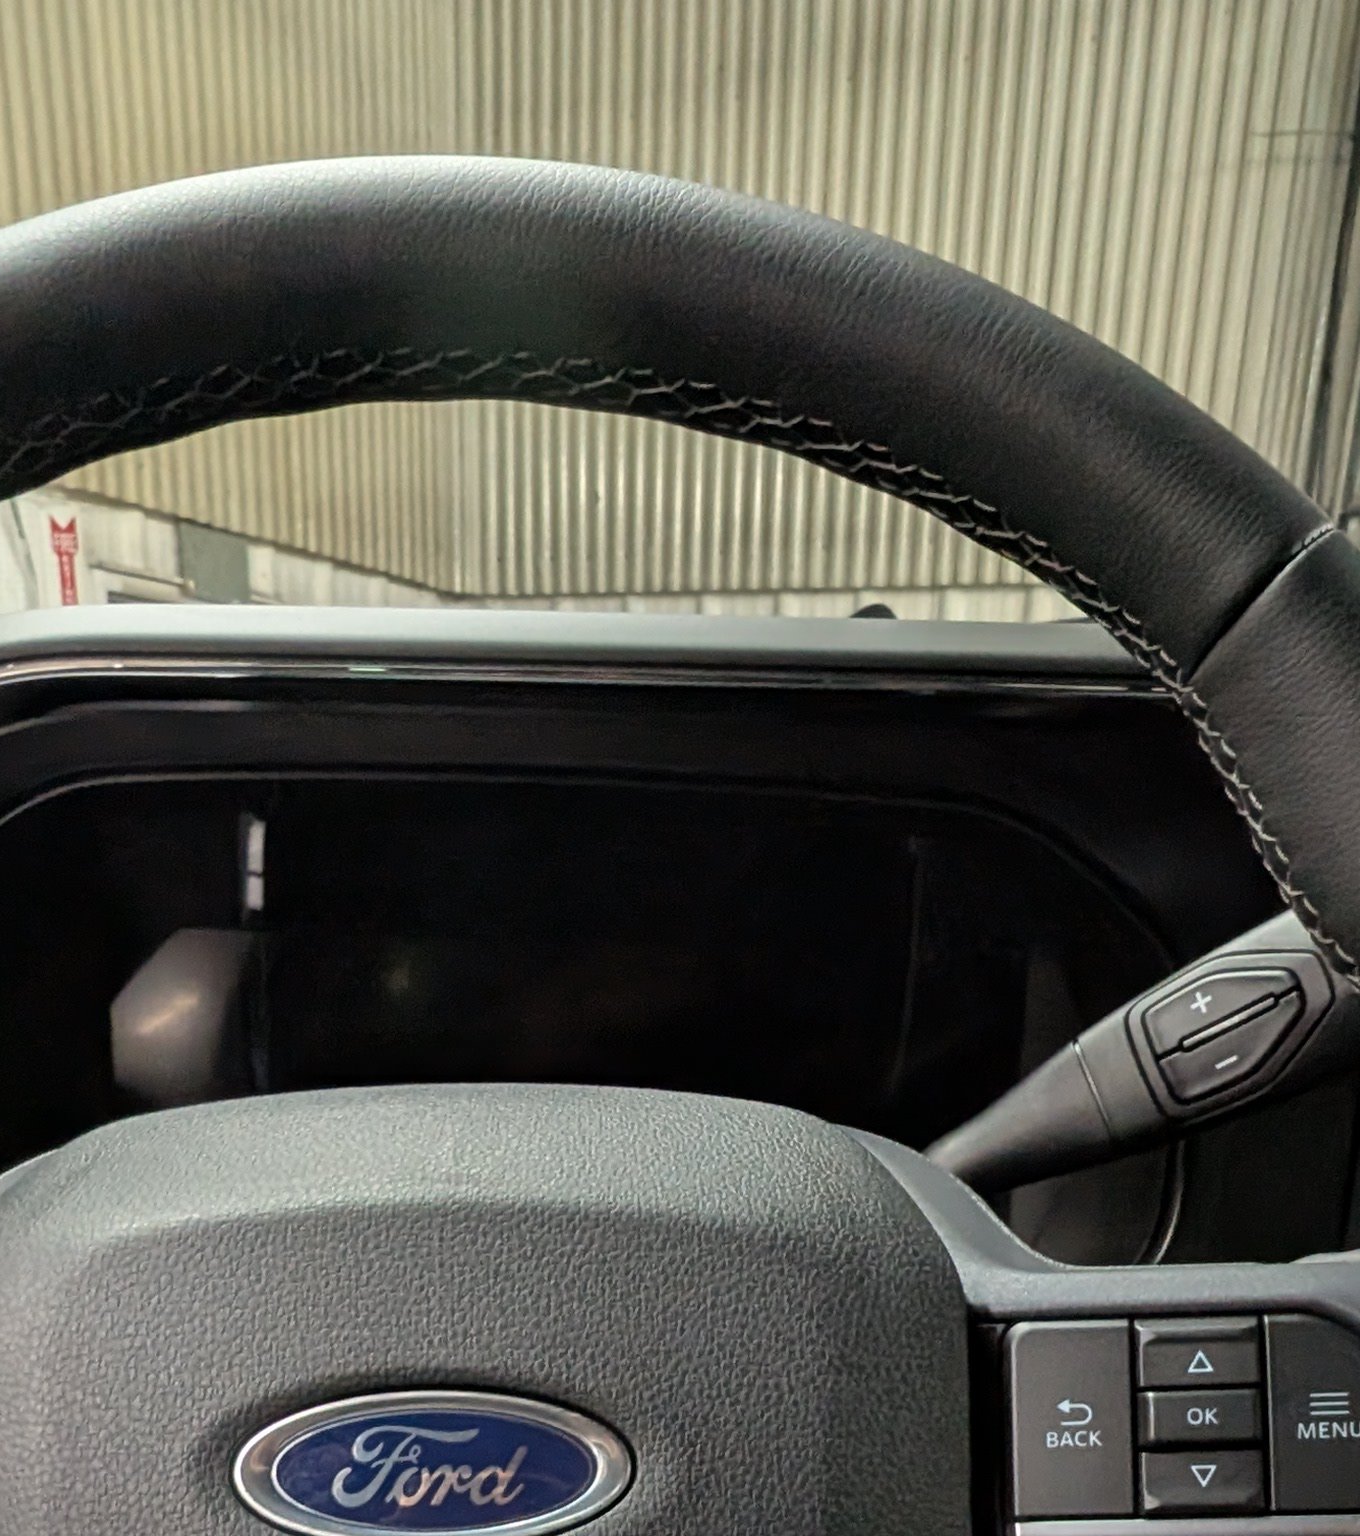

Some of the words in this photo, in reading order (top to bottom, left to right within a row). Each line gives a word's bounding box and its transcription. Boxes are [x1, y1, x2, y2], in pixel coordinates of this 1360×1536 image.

[1186, 1407, 1218, 1426] OK
[1045, 1430, 1103, 1449] BACK
[330, 1424, 530, 1509] Ford
